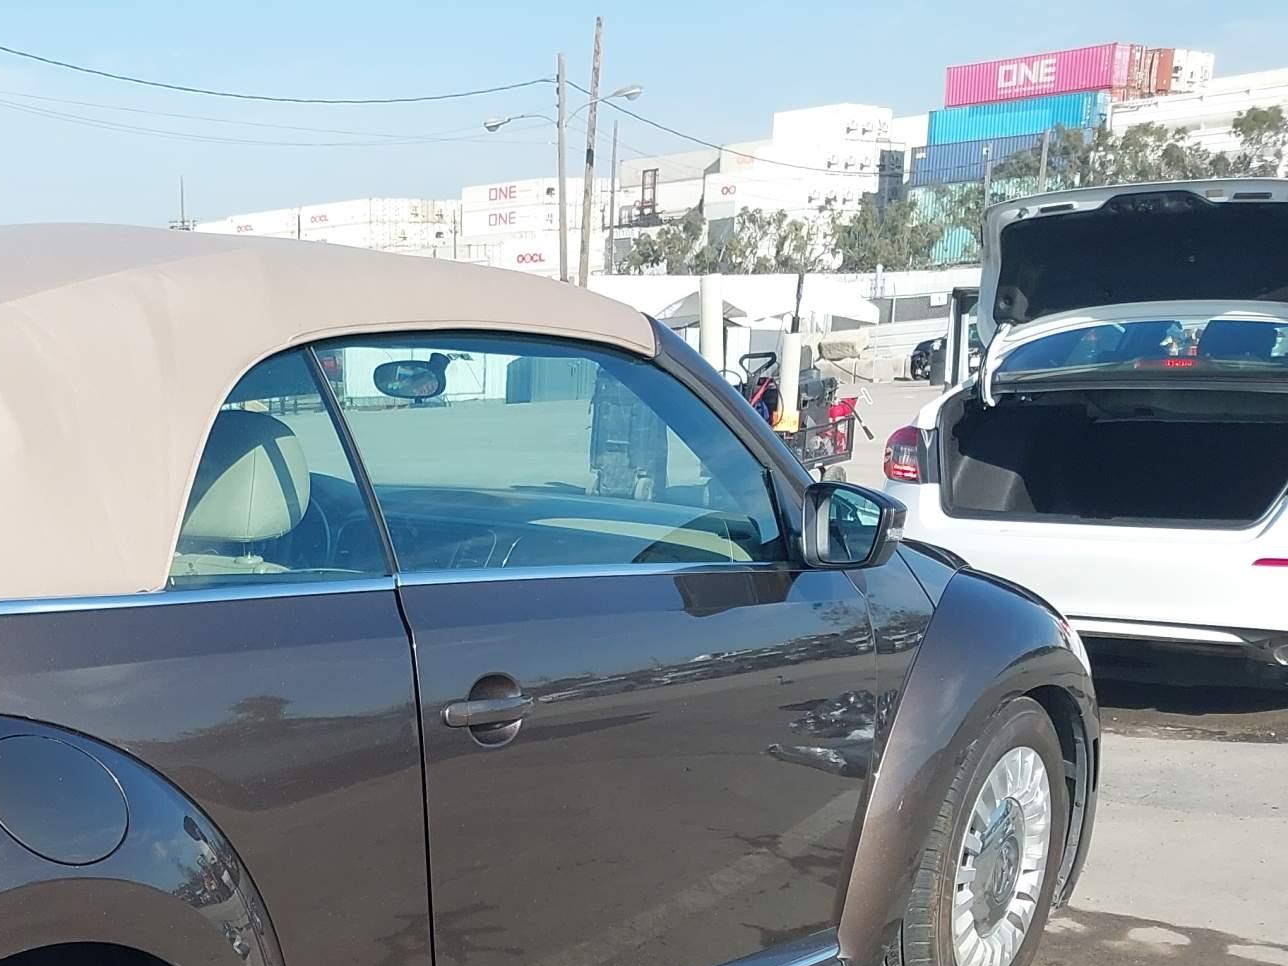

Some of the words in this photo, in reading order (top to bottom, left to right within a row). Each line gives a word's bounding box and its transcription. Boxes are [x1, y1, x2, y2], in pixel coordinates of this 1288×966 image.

[997, 58, 1057, 89] ONE
[488, 185, 517, 201] ONE
[488, 211, 517, 227] ONE
[516, 253, 545, 264] OOCL
